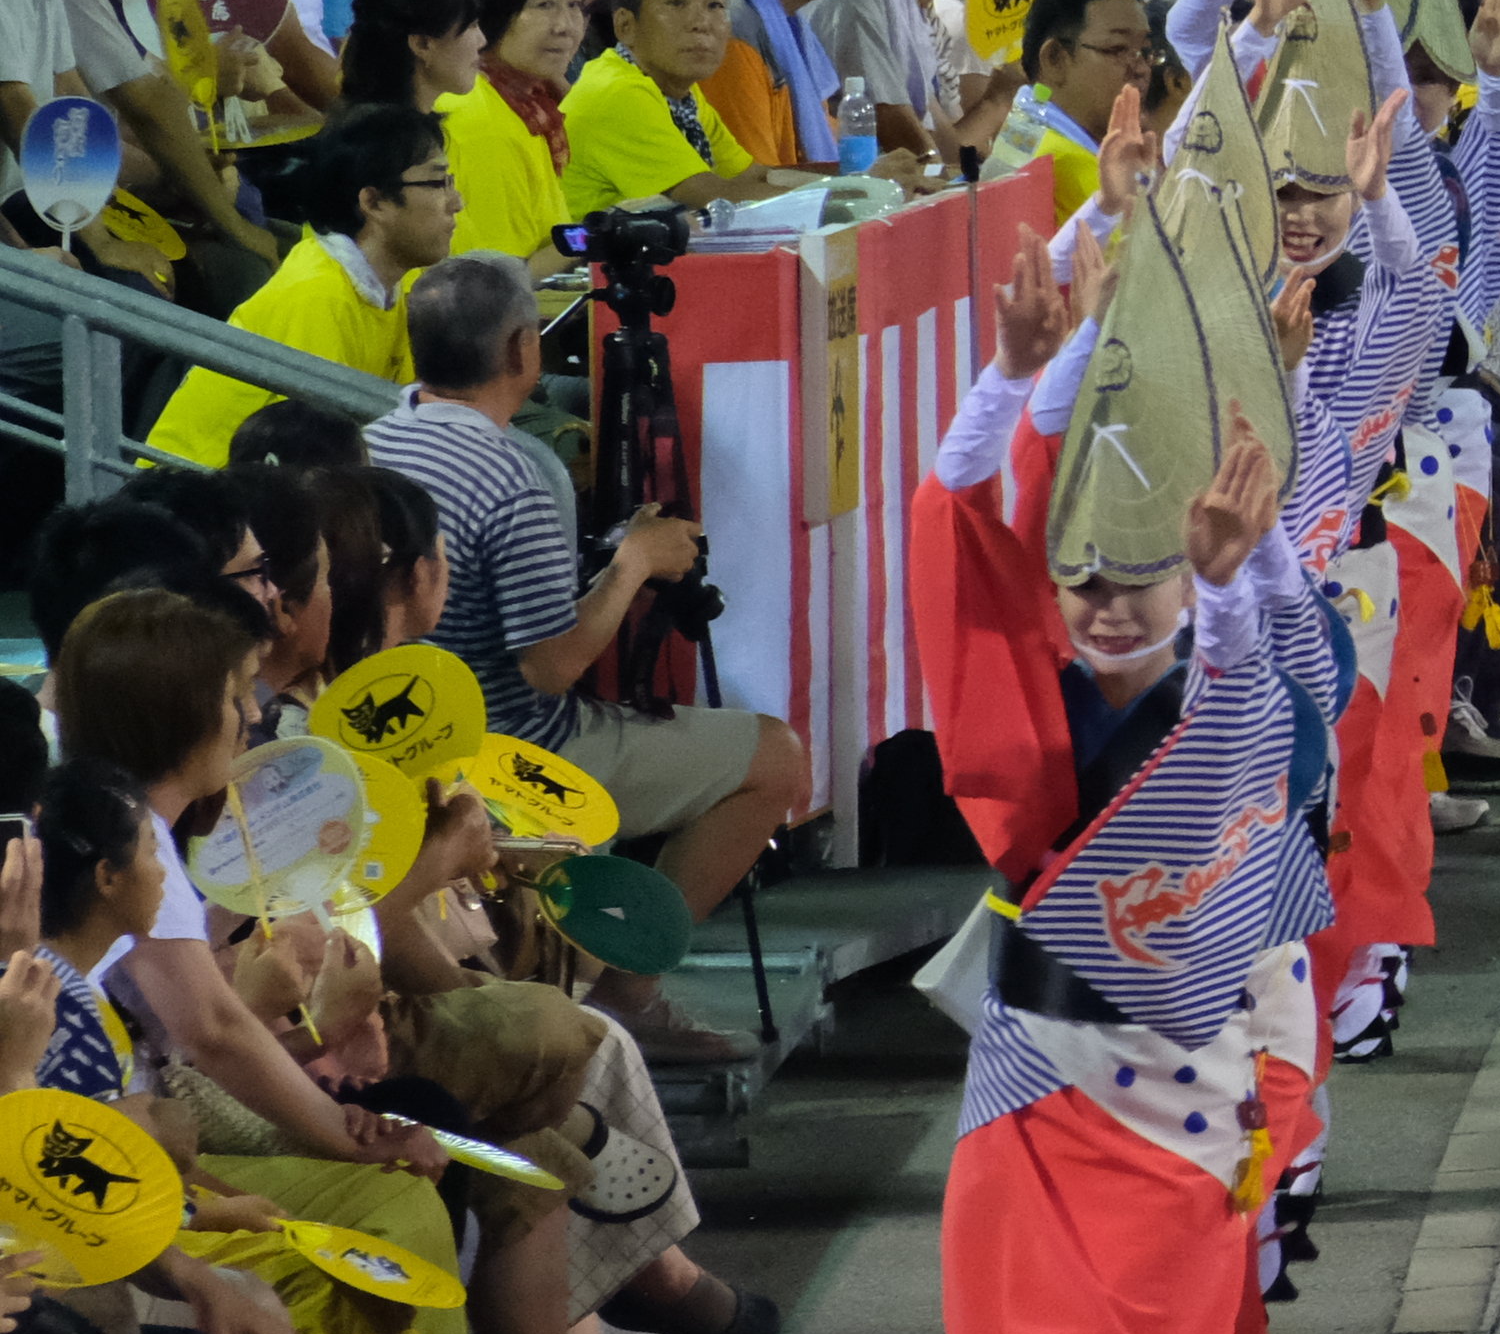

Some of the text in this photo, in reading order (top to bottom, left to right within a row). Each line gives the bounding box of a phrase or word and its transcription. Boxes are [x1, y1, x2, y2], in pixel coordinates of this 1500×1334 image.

[386, 723, 455, 769] トグループ
[489, 776, 576, 827] ヤマトグループ
[0, 1176, 109, 1247] ヤマトグループ
